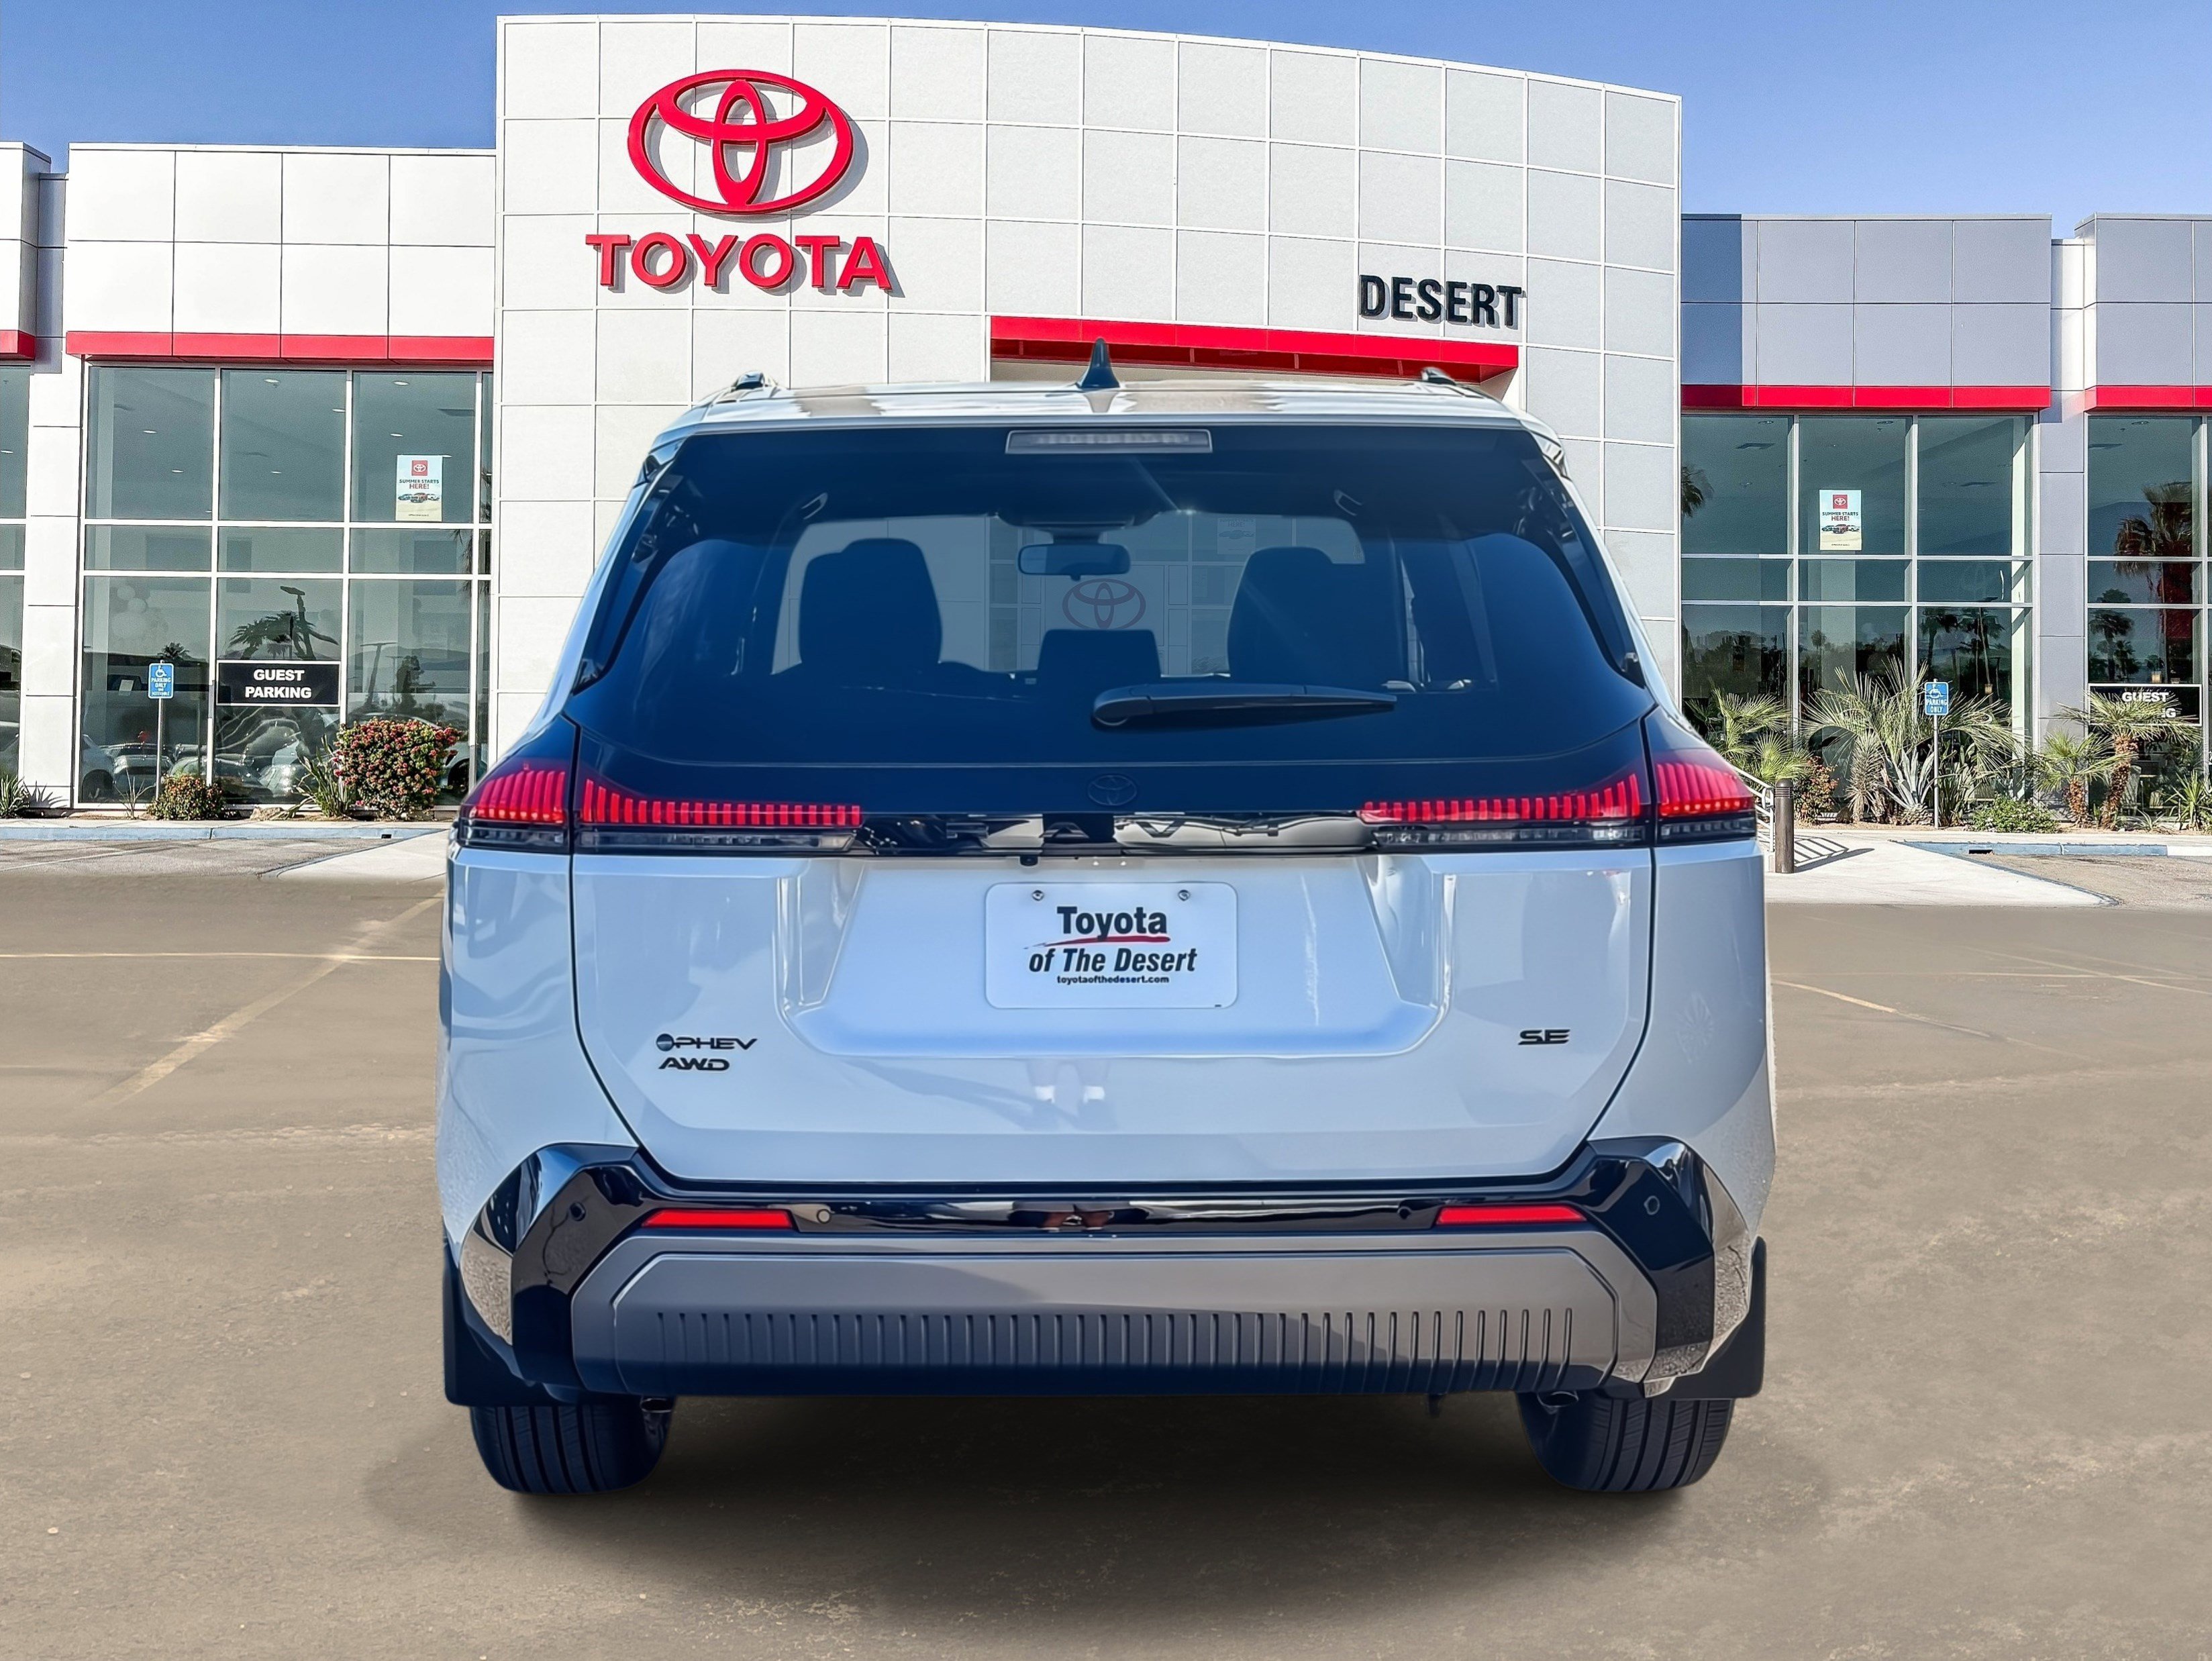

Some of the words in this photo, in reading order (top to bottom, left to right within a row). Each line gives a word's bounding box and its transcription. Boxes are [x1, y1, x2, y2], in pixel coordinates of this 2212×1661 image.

[586, 232, 893, 290] TOYOTA
[1359, 274, 1522, 327] DESERT
[253, 668, 305, 681] GUEST
[245, 686, 312, 699] PARKING
[2121, 691, 2170, 703] GUEST
[1056, 906, 1167, 941] Toyota
[1028, 948, 1056, 972] of
[1062, 948, 1106, 972] The
[1113, 948, 1198, 972] Desert
[1056, 974, 1170, 985] toyotaofthedesert.com
[673, 1036, 758, 1050] PHEV
[1518, 1029, 1570, 1046] SE
[658, 1056, 730, 1071] AWD
